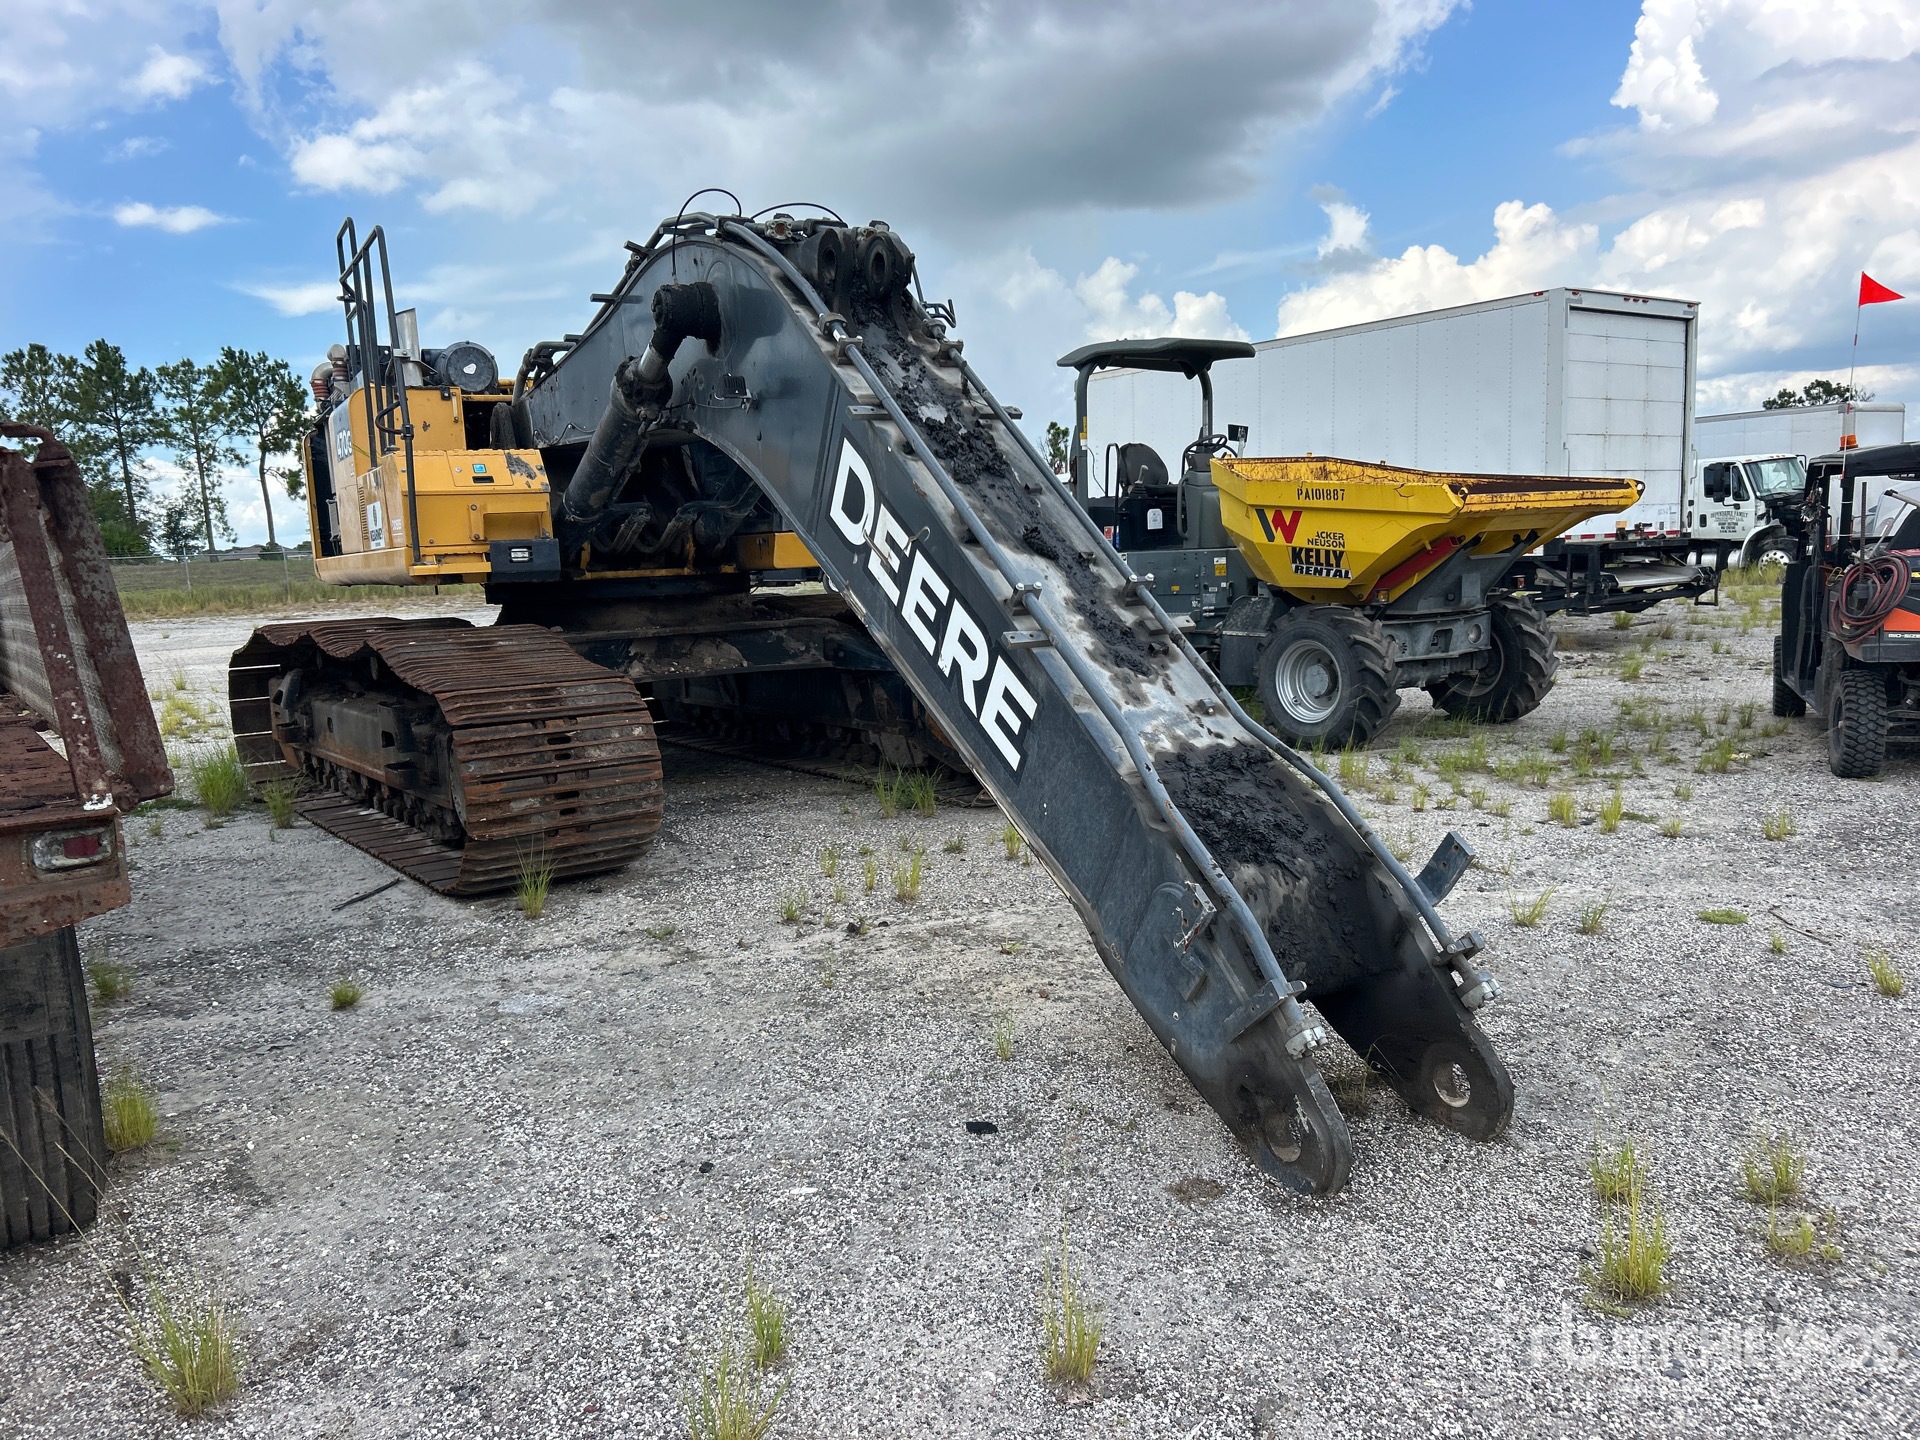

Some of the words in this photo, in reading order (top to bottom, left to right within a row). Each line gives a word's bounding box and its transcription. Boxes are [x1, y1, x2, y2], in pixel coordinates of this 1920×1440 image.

[1297, 487, 1345, 501] PA101887
[1307, 538, 1345, 549] NEUSON
[1291, 546, 1345, 568] KELLY
[1294, 565, 1352, 579] RENTAL
[829, 437, 1038, 772] DEERE
